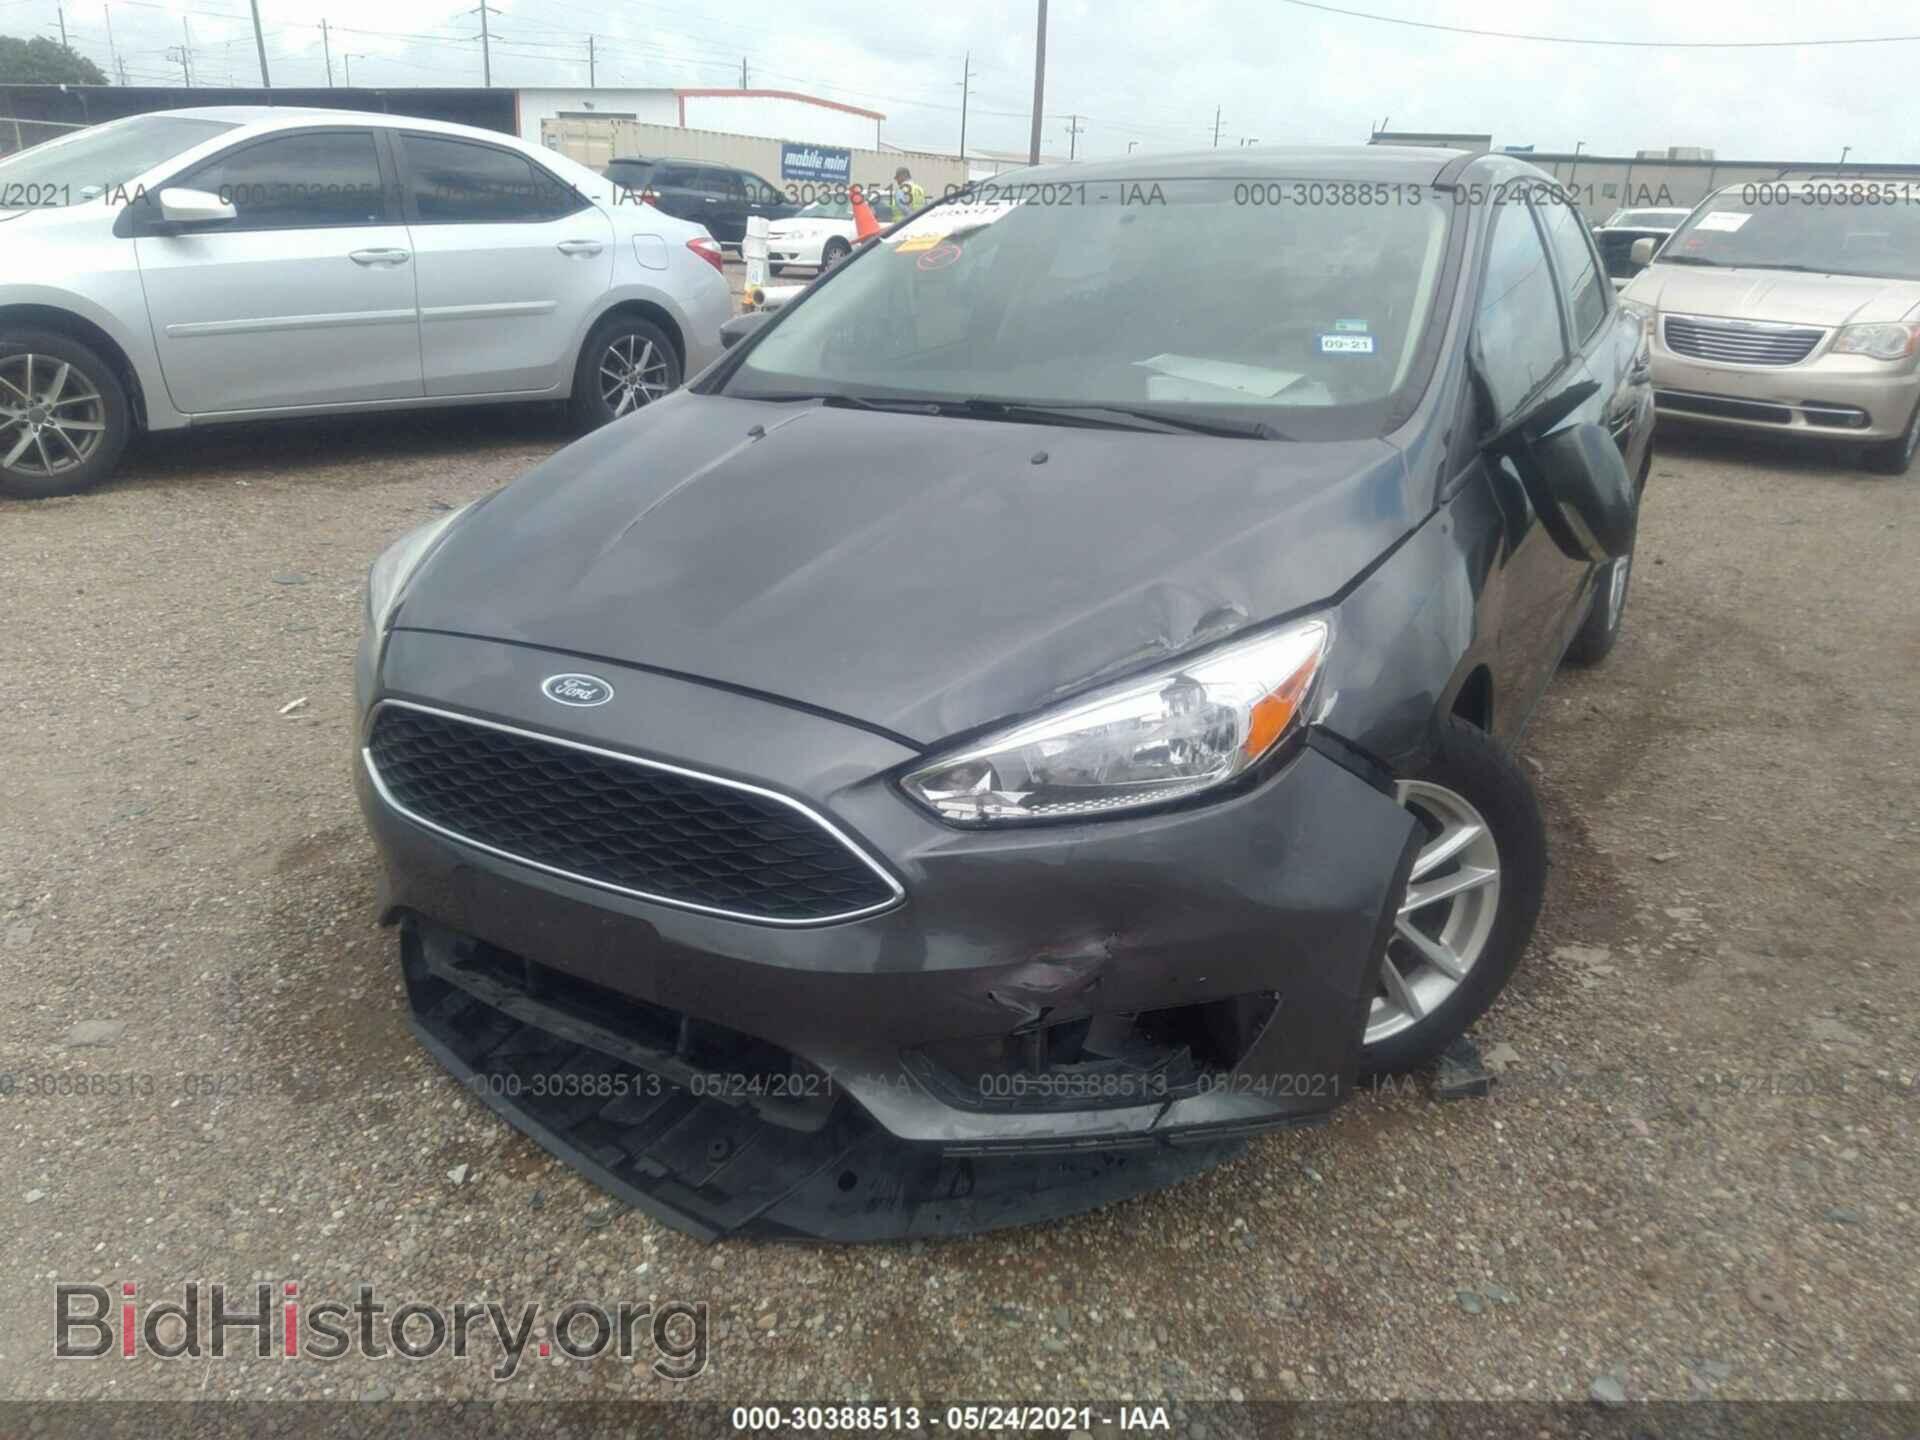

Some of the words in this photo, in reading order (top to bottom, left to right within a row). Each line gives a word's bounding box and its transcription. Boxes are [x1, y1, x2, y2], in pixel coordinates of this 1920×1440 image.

[784, 149, 823, 168] mobile
[823, 155, 848, 171] mini
[1325, 340, 1369, 349] 09-21
